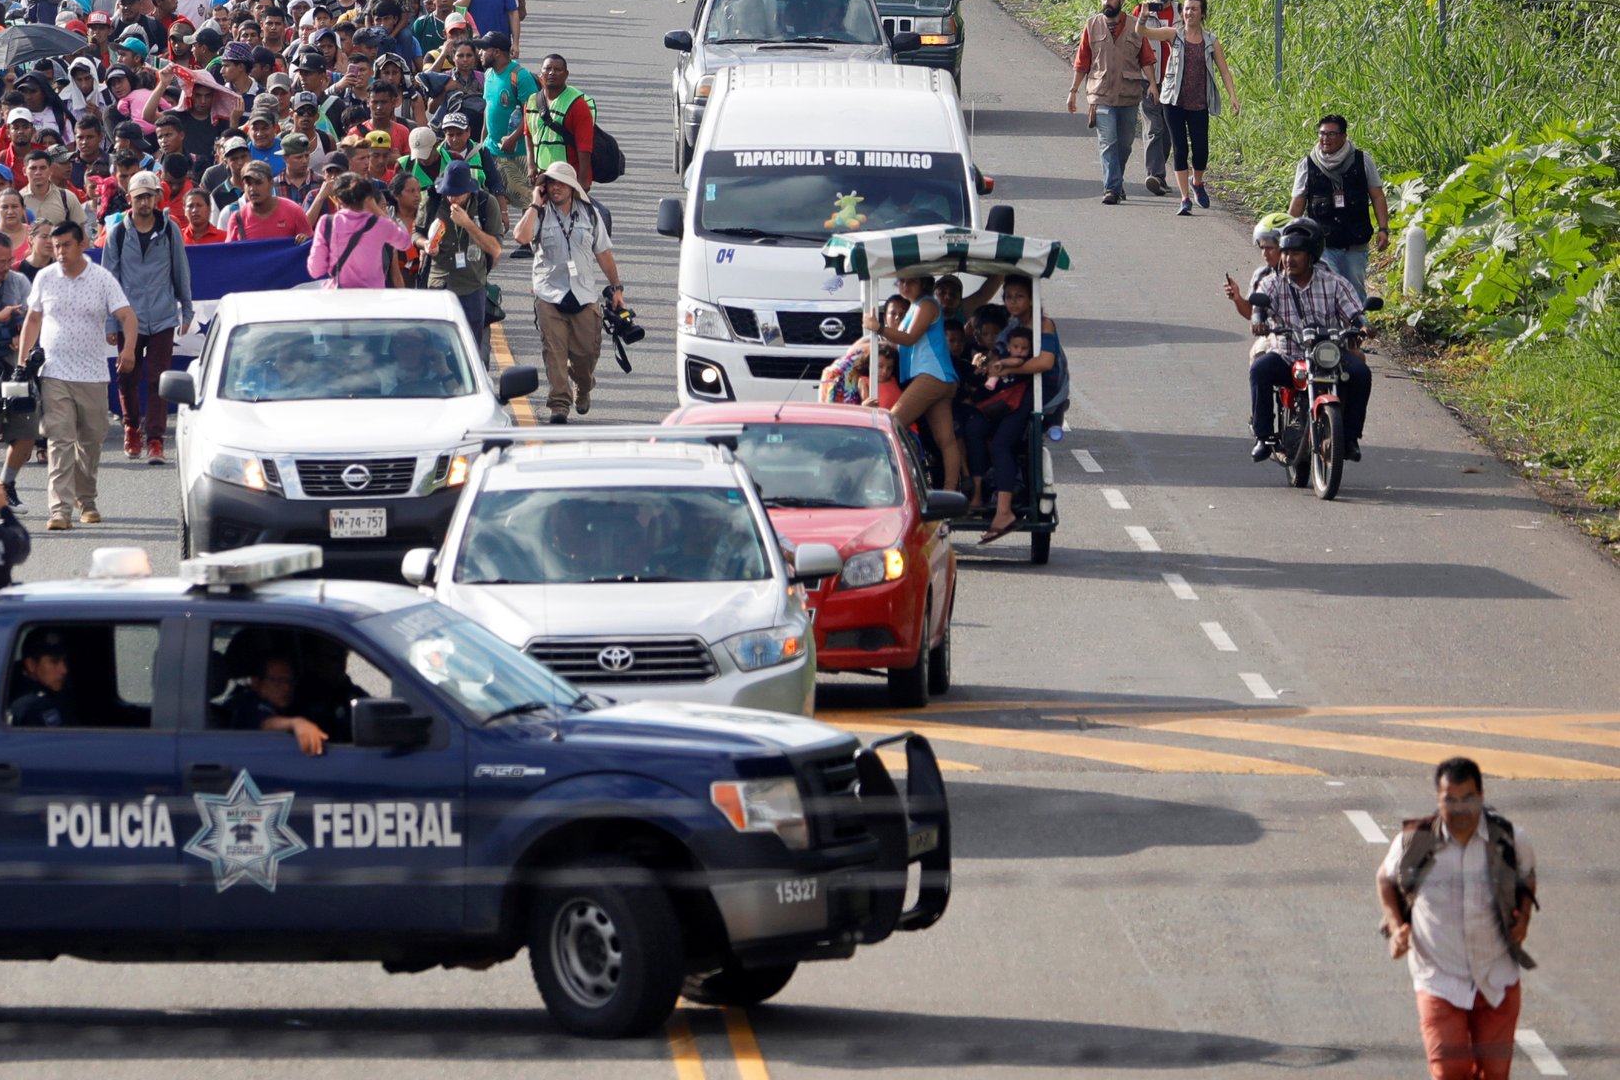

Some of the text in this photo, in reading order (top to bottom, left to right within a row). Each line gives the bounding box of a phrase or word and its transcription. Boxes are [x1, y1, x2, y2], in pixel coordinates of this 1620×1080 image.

[834, 150, 861, 167] CD.
[864, 152, 933, 170] HIDALGO
[716, 248, 736, 264] 04
[47, 794, 462, 849] POLICÍA FEDERAL
[776, 878, 818, 904] 15327
